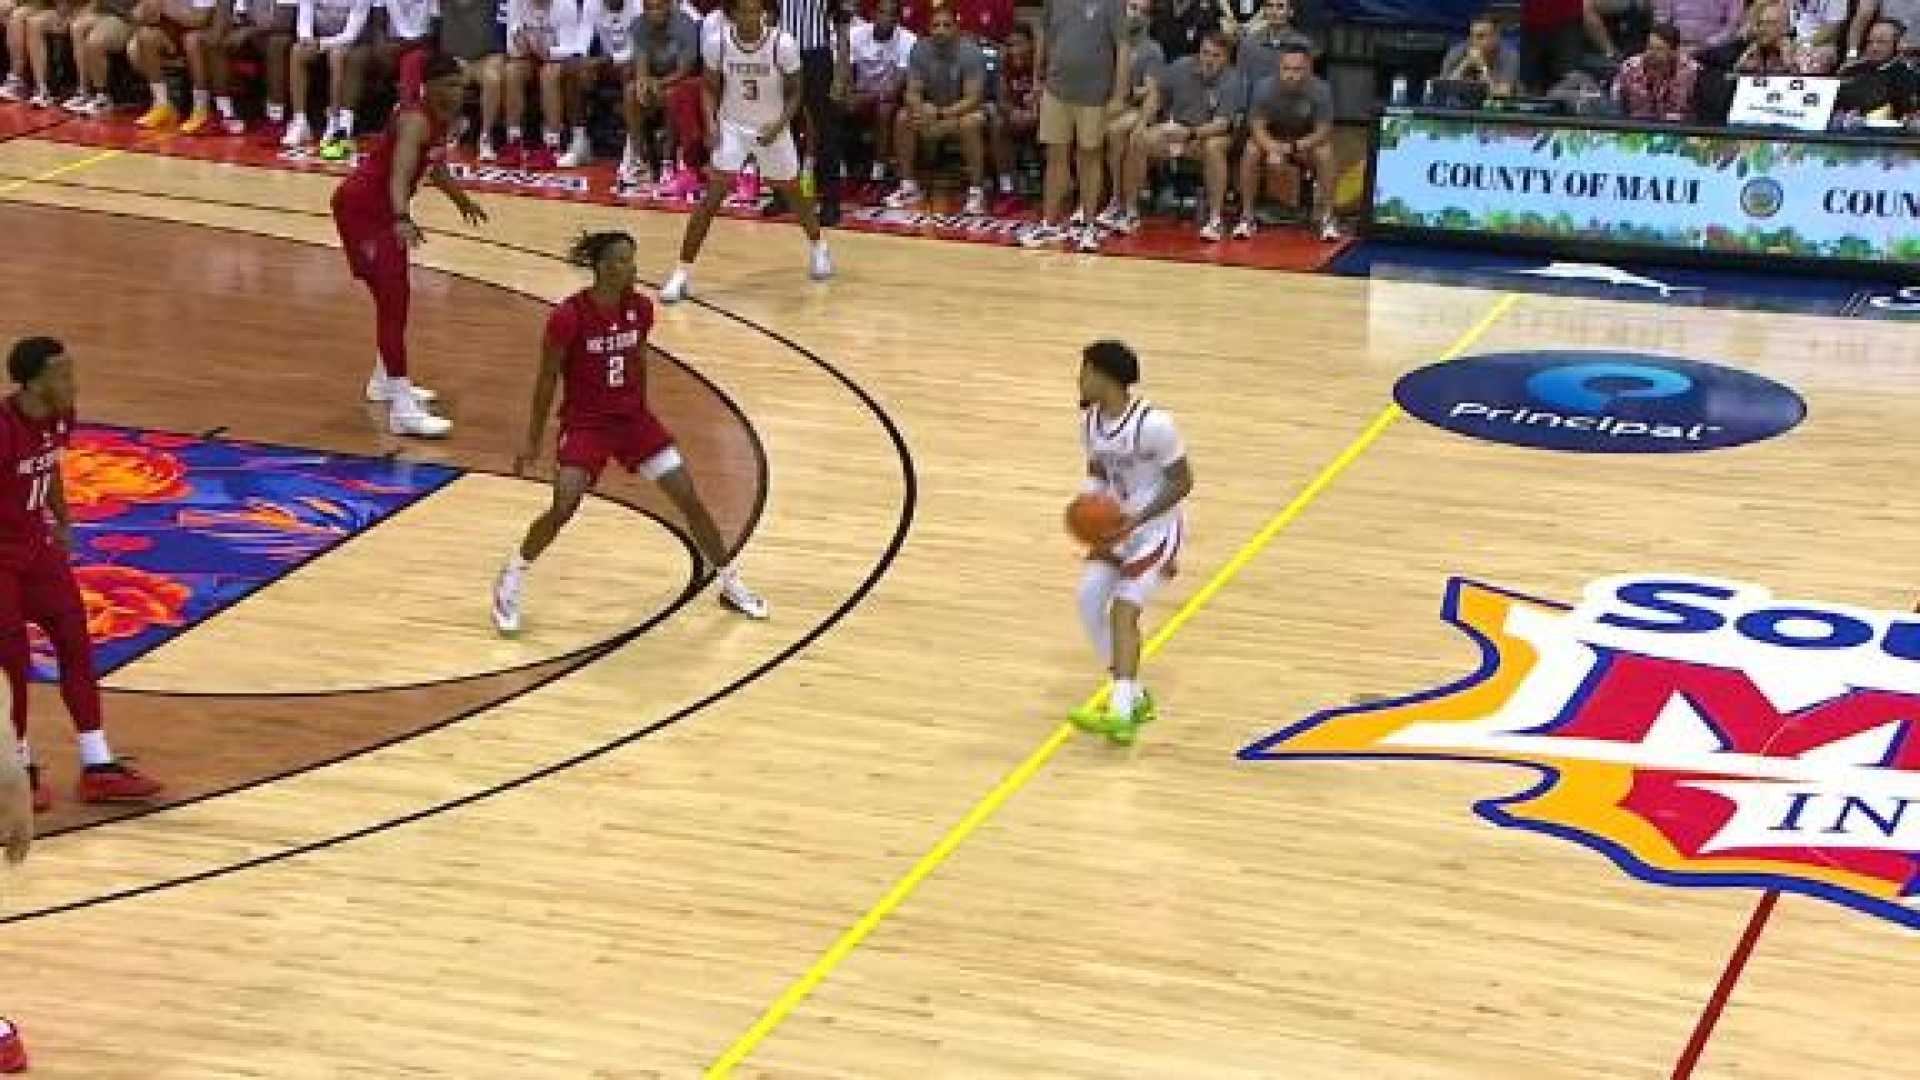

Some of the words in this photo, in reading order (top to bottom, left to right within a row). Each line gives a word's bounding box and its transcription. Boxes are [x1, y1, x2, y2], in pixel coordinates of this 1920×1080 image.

[743, 80, 758, 101] 3
[1427, 159, 1557, 194] COUNTY
[1563, 169, 1609, 198] OF
[1613, 175, 1705, 204] MAUI
[609, 356, 624, 387] 2
[1449, 401, 1704, 442] Principal
